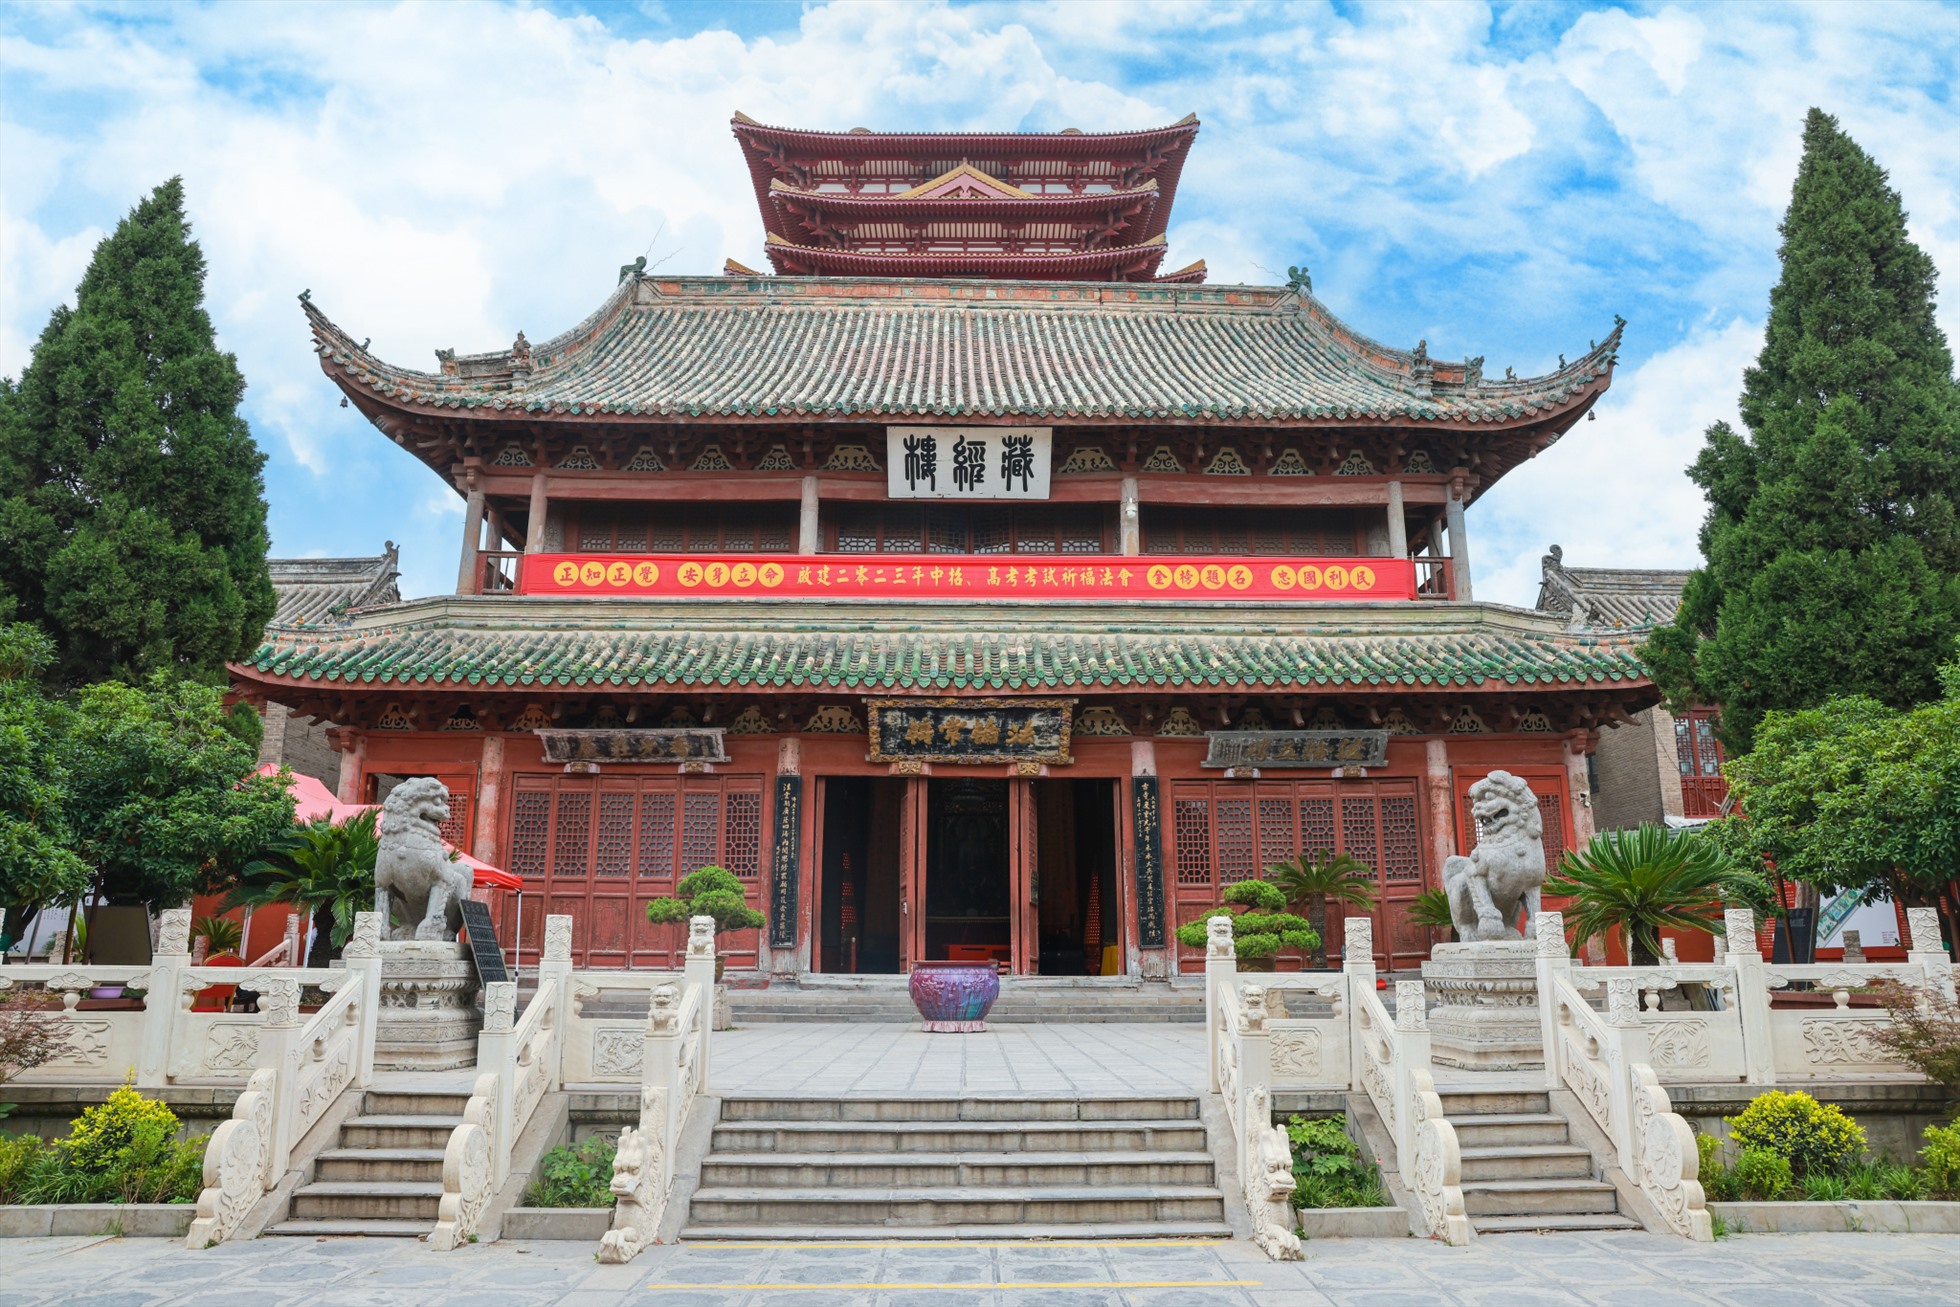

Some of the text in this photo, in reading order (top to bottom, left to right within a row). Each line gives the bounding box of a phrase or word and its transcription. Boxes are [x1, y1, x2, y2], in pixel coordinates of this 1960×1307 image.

[558, 565, 655, 584] 正知正覺
[682, 565, 780, 585] 安身立命
[1150, 567, 1248, 587] 金榜題名
[1276, 568, 1372, 588] 忠國利民
